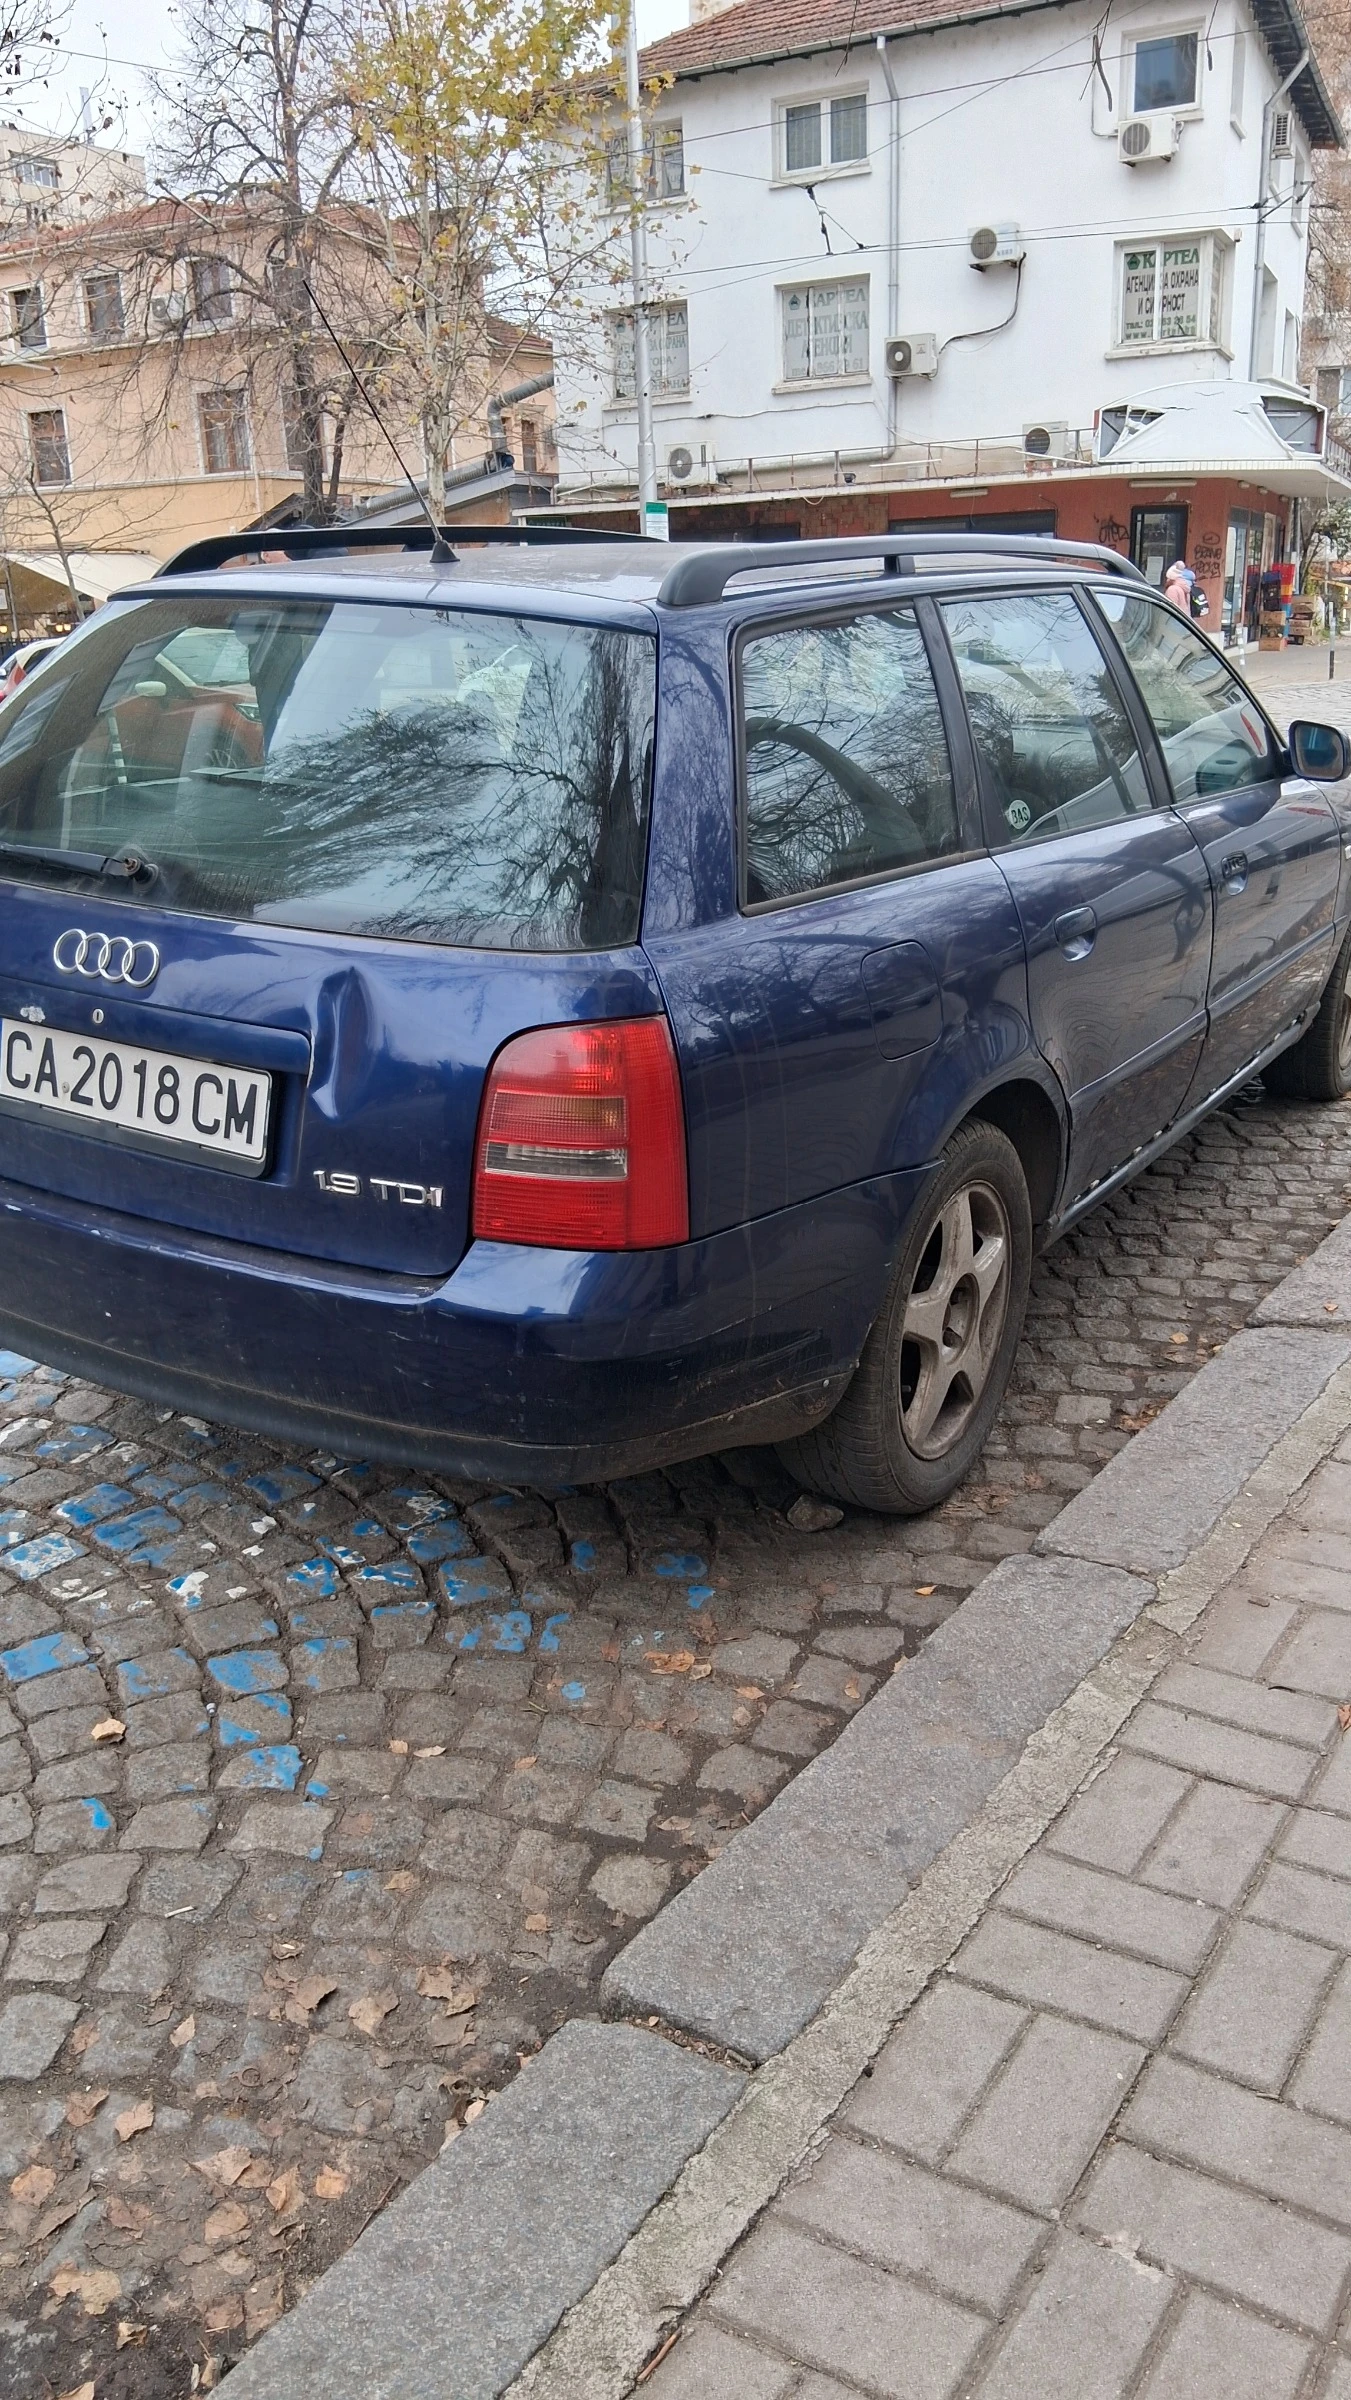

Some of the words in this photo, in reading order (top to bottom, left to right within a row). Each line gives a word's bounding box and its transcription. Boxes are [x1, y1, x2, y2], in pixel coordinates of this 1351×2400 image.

[1142, 248, 1200, 269] КРТЕЛ
[1126, 273, 1156, 295] АГЕНЦИ
[1171, 269, 1199, 289] ОХРАНА
[1145, 293, 1186, 315] СИРНОСТ
[1011, 806, 1029, 824] BAS
[6, 1030, 59, 1098] CA
[70, 1045, 181, 1125] 2018
[192, 1072, 258, 1145] CM
[370, 1178, 443, 1207] TDI
